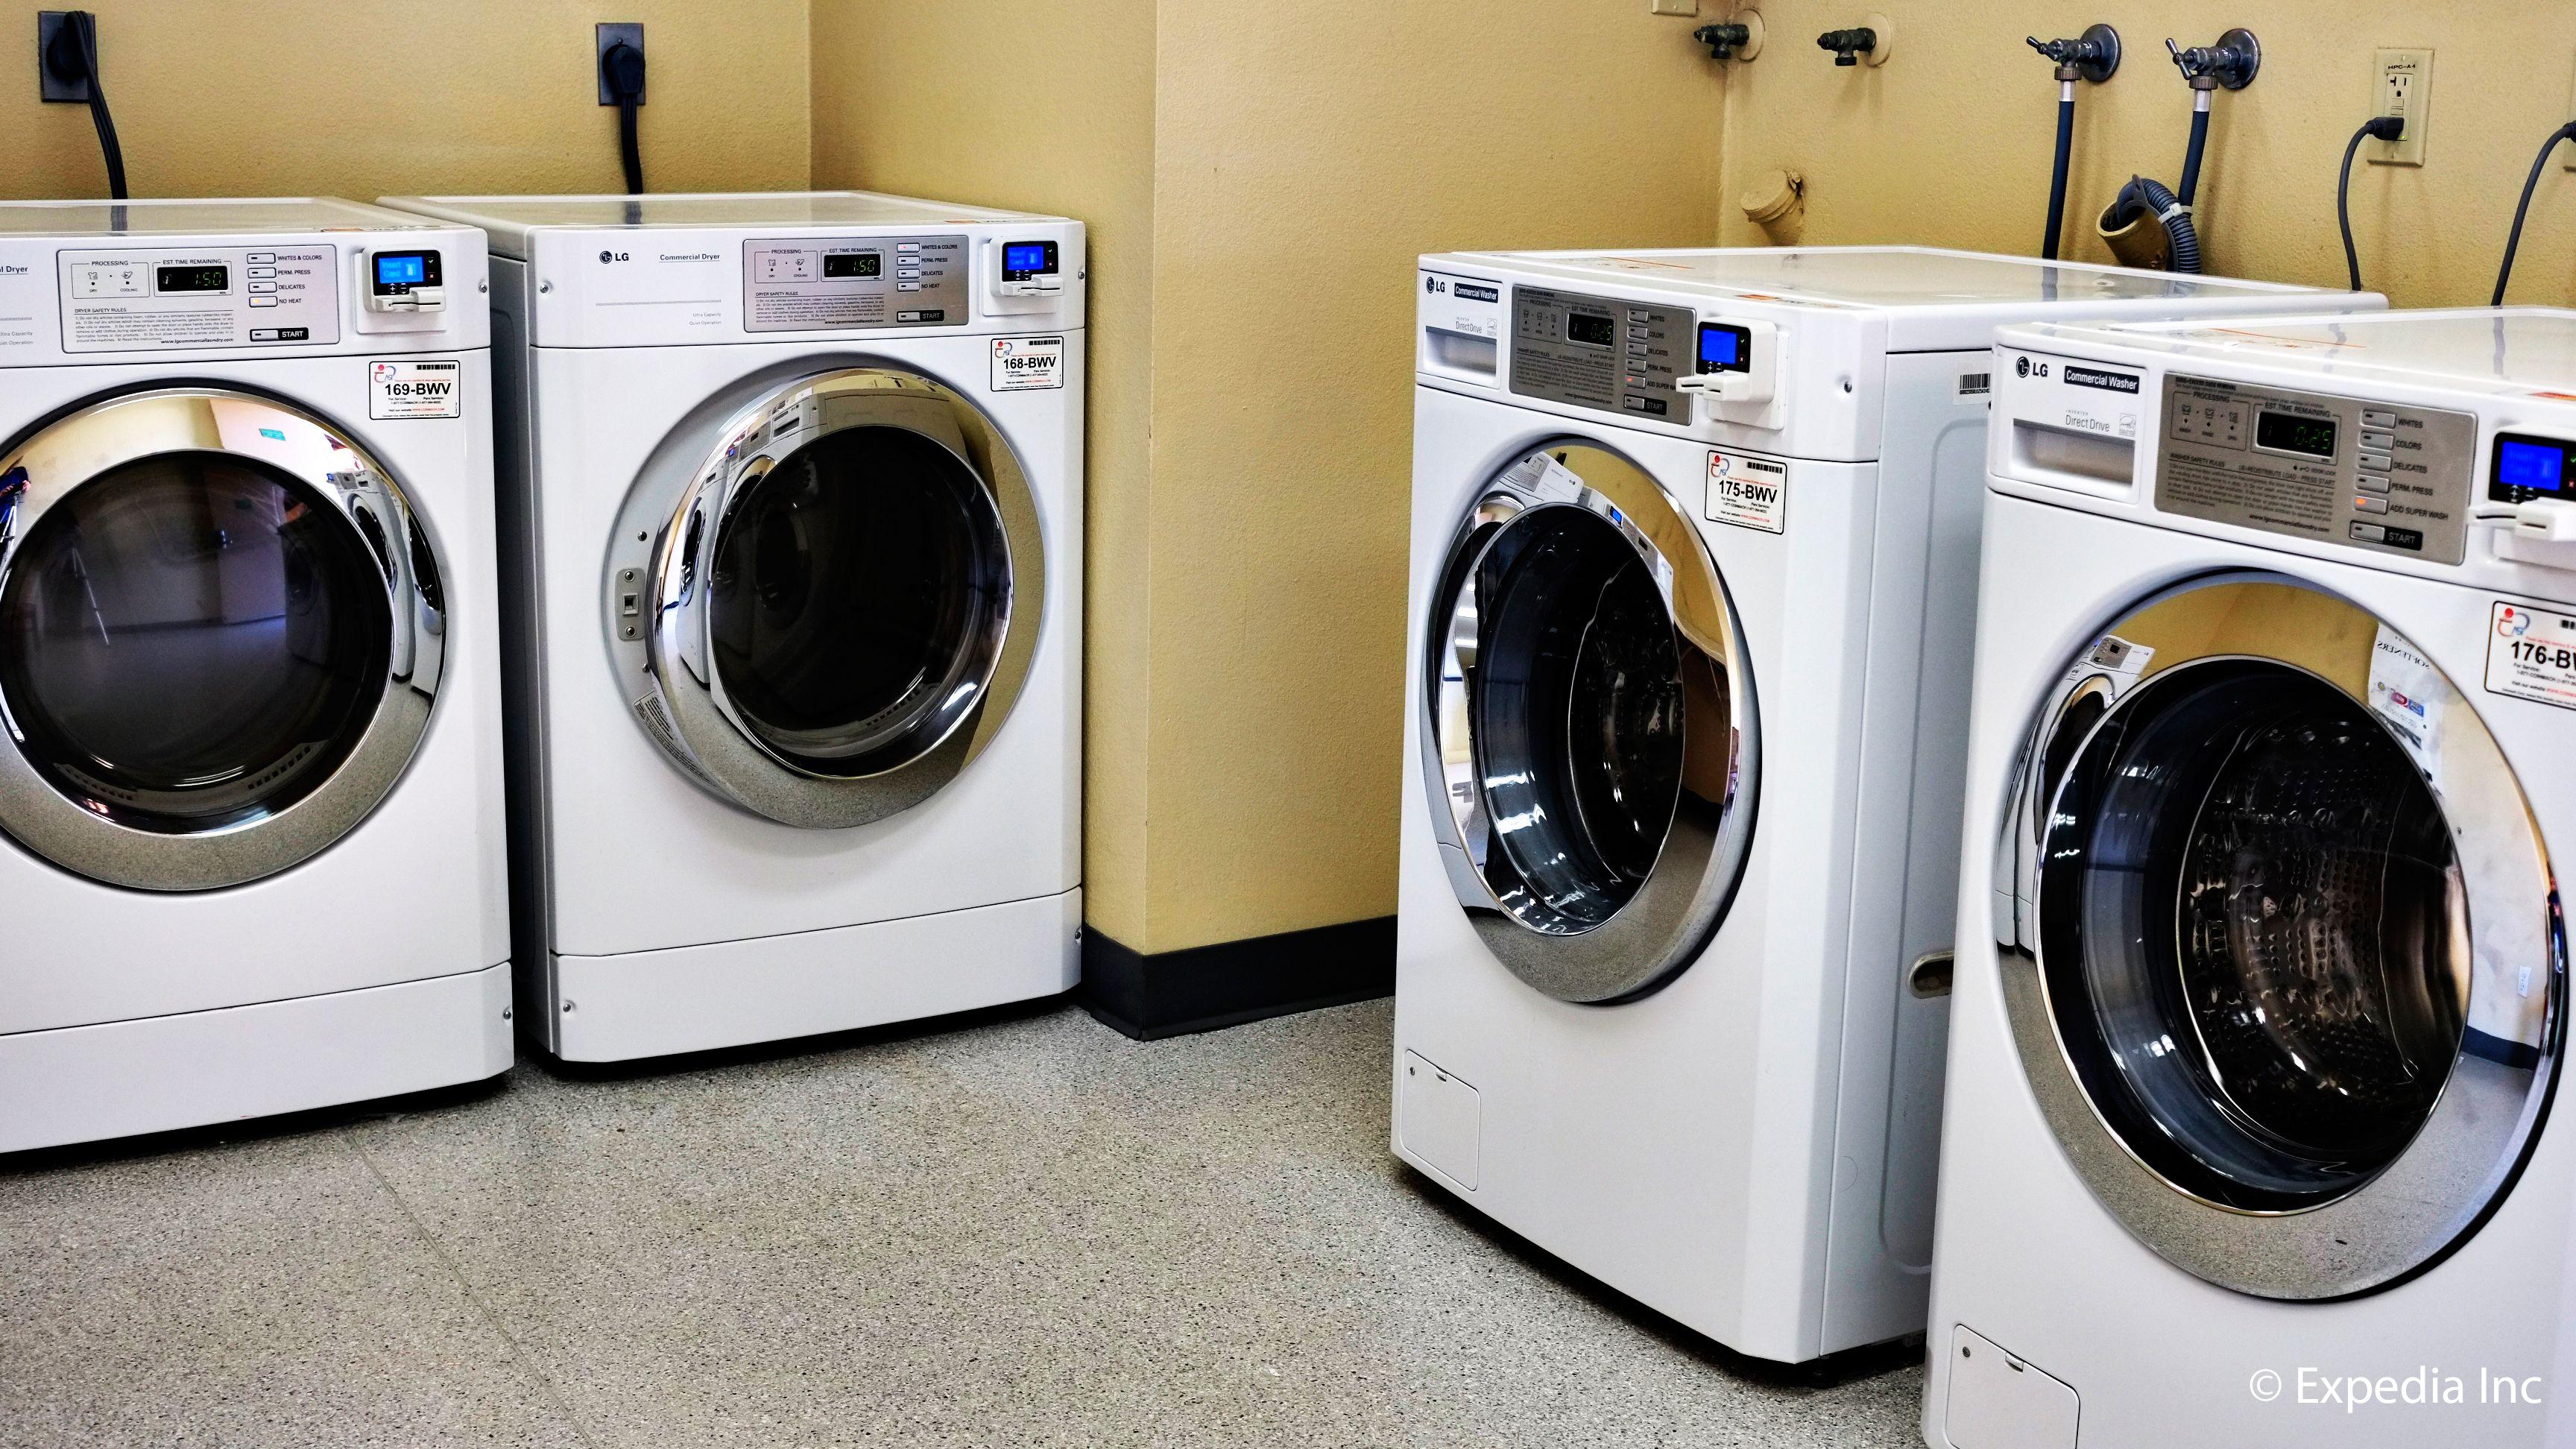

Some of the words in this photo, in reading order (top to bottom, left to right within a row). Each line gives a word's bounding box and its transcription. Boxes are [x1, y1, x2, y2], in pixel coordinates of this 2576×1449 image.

[615, 253, 629, 262] LG
[6, 265, 28, 274] Dryer
[1436, 280, 1445, 293] LG
[1455, 285, 1480, 297] Commercial
[1480, 289, 1497, 300] Washer
[1530, 299, 1552, 308] PROCESSING
[1588, 308, 1611, 316] REMAINING
[1456, 321, 1470, 331] Direct
[1470, 323, 1483, 334] Drive
[282, 330, 304, 338] START
[1647, 348, 1668, 357] DELICATES
[1003, 356, 1057, 370] 168-BWV
[2032, 362, 2048, 378] LG
[1655, 382, 1670, 391] SUPER
[2066, 370, 2107, 386] Commercial
[2108, 376, 2138, 391] Washer
[385, 382, 452, 396] 169-BWV
[2193, 391, 2230, 403] PROCESSING
[1647, 402, 1664, 411] START
[2278, 403, 2293, 412] TIME
[2294, 405, 2331, 418] REMAINING
[2065, 414, 2088, 429] Direct
[2089, 419, 2110, 432] Drive
[2398, 419, 2424, 429] WHITES
[2396, 440, 2422, 450] COLORS
[2209, 459, 2225, 467] RULES
[2393, 461, 2428, 474] DELICATES
[1719, 479, 1778, 504] 175-BWV
[2412, 487, 2434, 496] PRESS
[2389, 505, 2405, 514] ADD
[2405, 507, 2428, 517] SUPER
[2428, 511, 2449, 521] WASH
[2388, 531, 2416, 544] START
